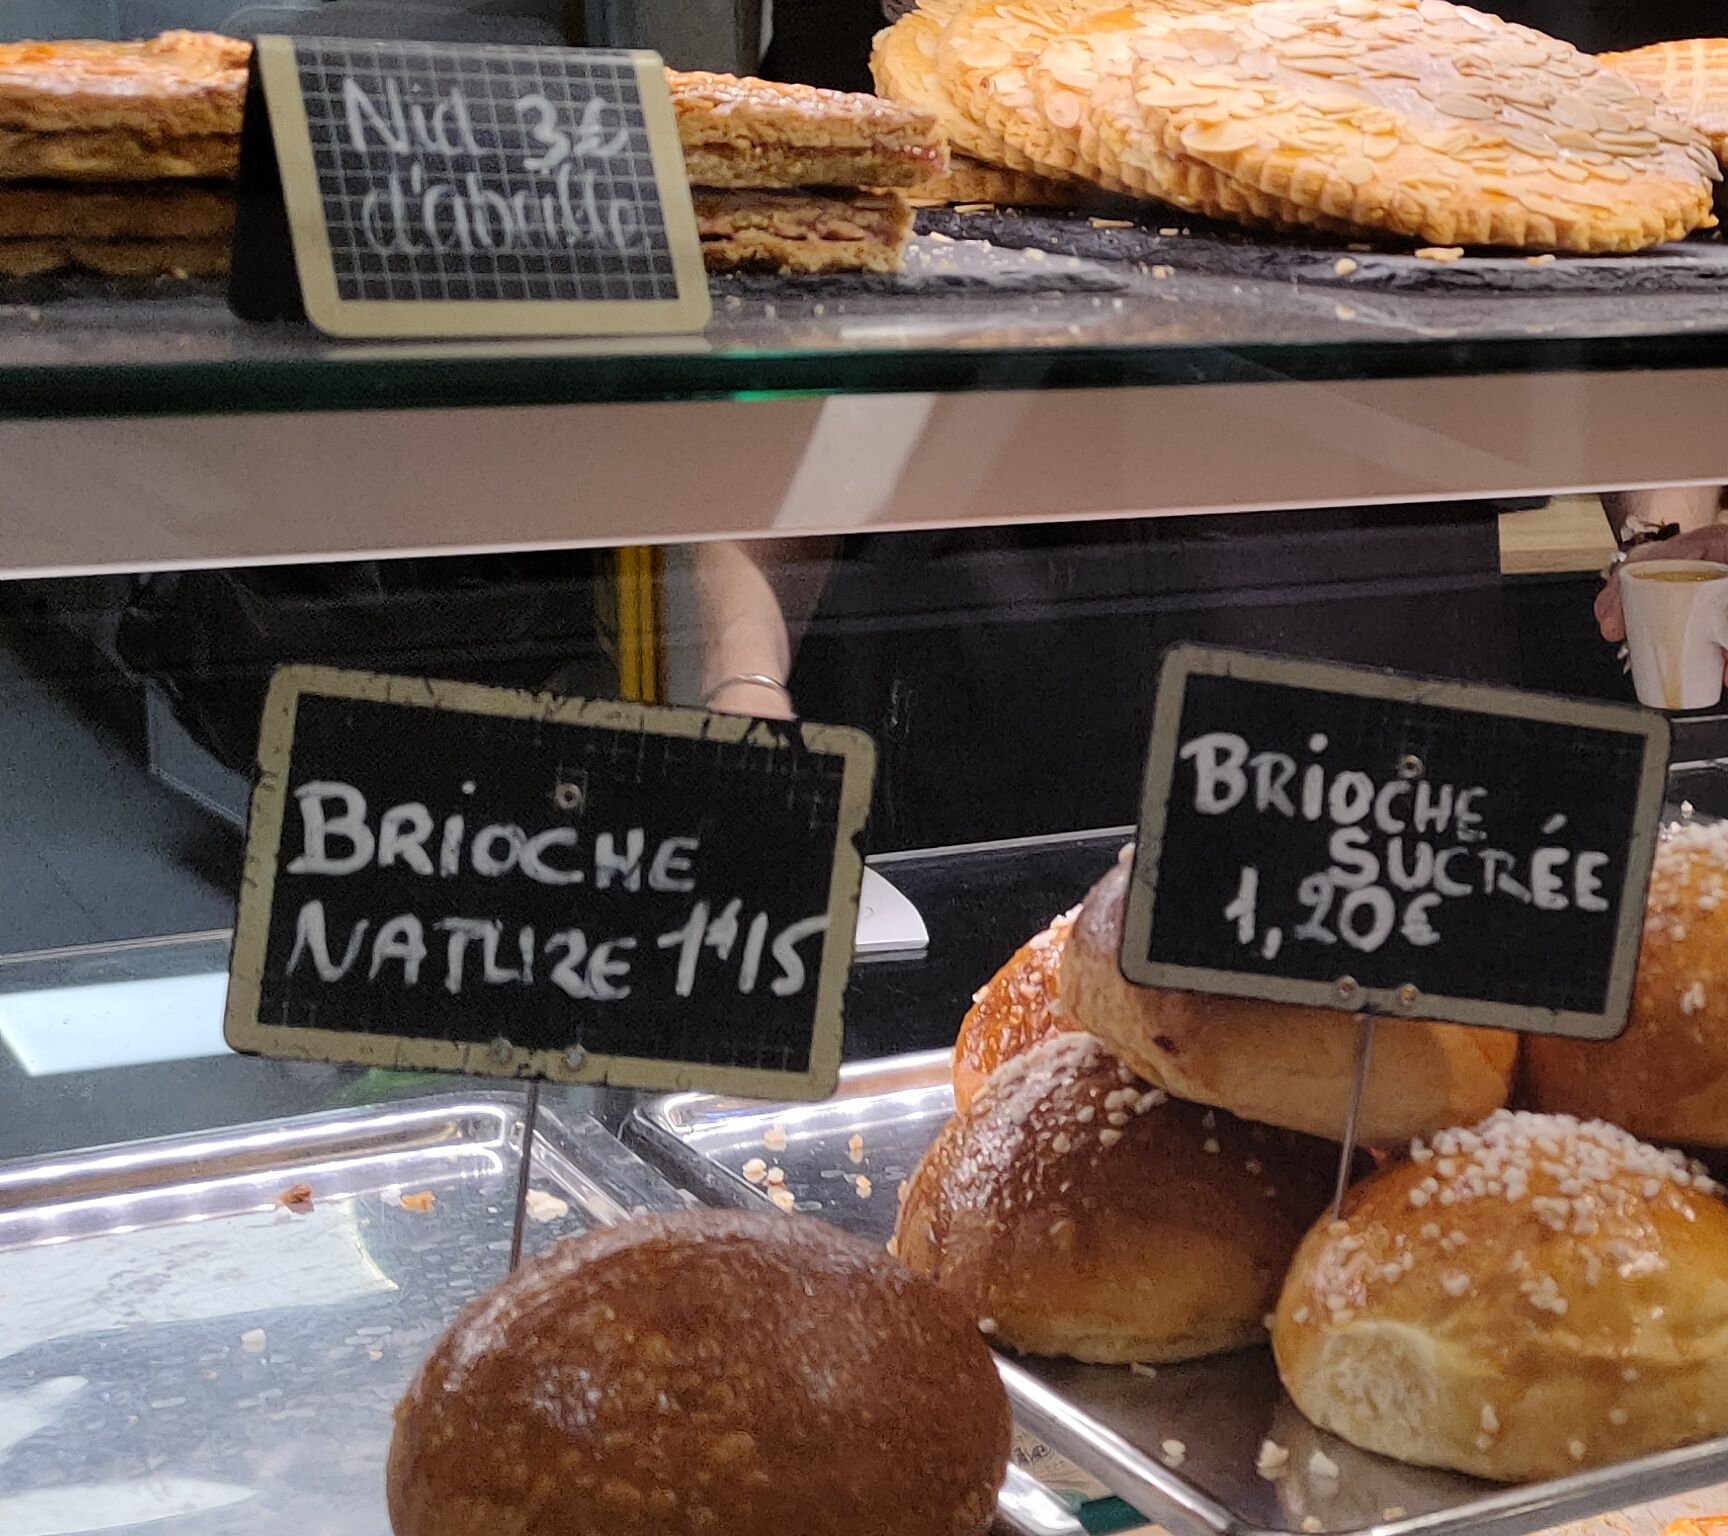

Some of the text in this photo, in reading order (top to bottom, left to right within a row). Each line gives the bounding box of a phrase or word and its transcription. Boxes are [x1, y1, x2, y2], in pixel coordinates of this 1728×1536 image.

[342, 76, 629, 175] Nid 3€
[1327, 813, 1611, 912] SUCRÉE
[286, 899, 638, 1001] NATURE
[1223, 865, 1444, 961] 1,20€
